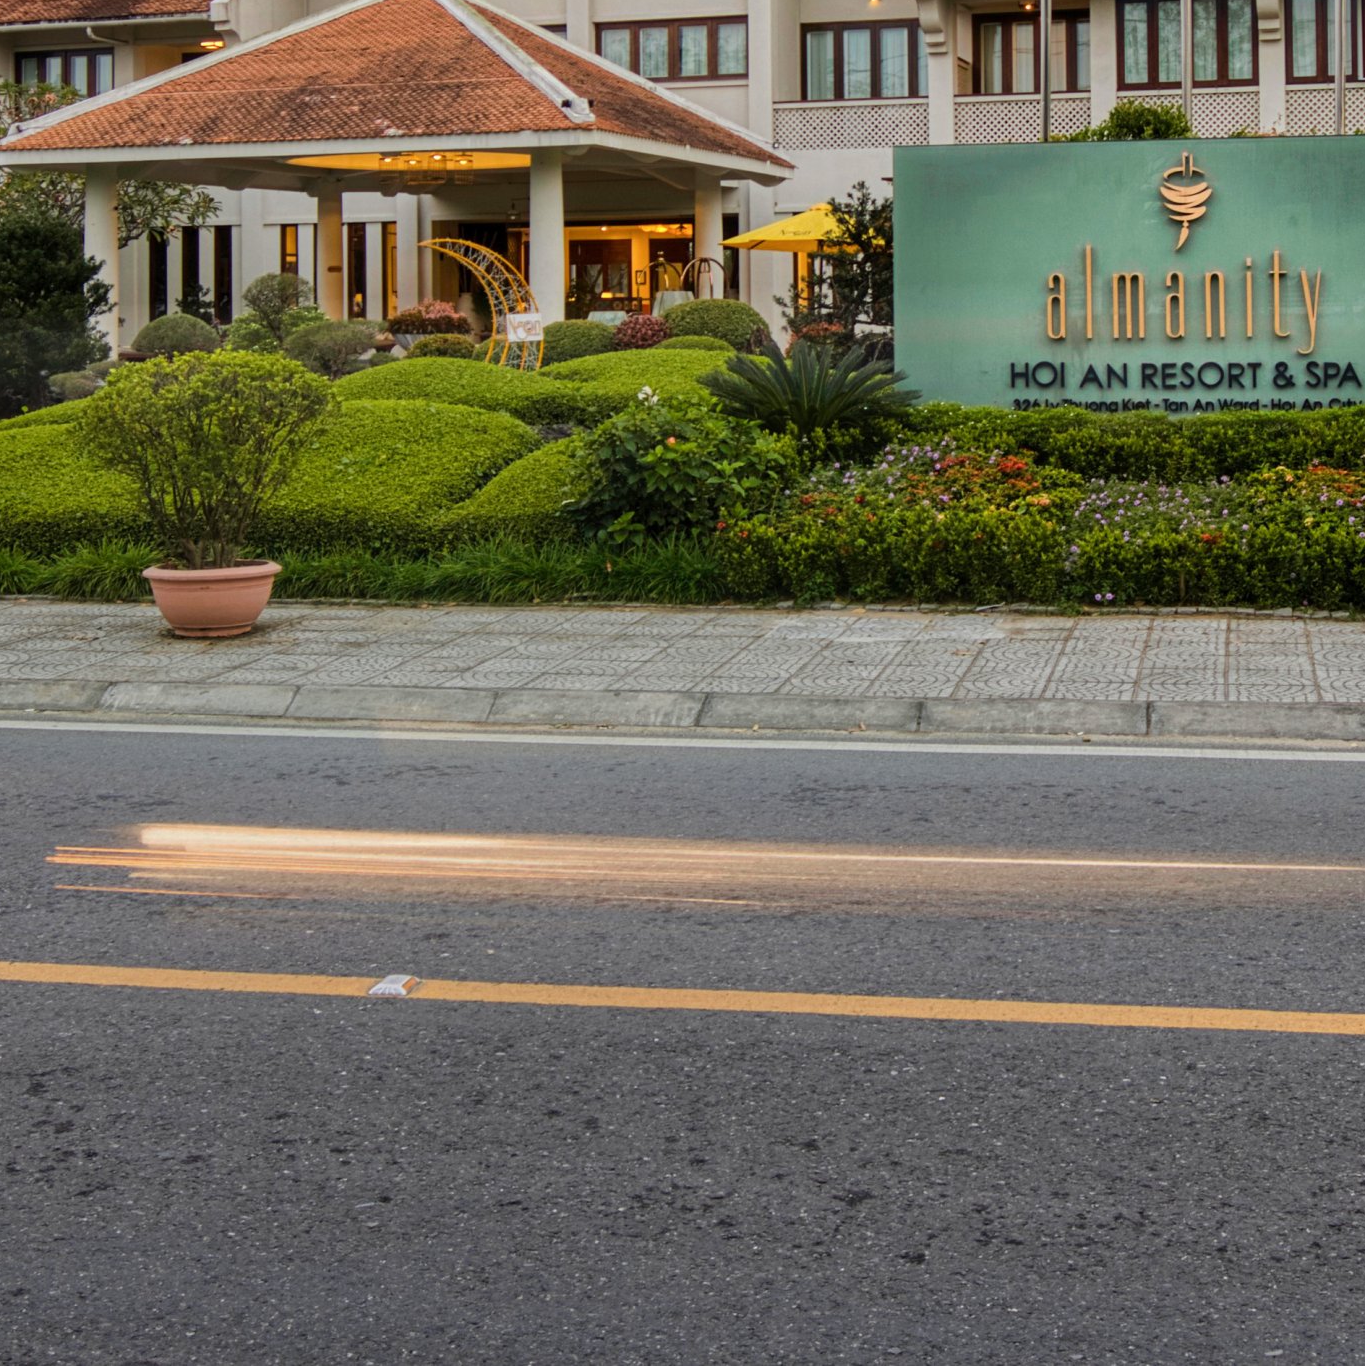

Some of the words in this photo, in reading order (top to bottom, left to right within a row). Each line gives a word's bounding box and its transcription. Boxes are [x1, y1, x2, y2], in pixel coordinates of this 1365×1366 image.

[1046, 243, 1322, 355] almanity
[1010, 361, 1066, 389] HOI
[1079, 362, 1129, 389] AN
[1141, 361, 1262, 390] RESORT
[1272, 361, 1297, 389] &
[1305, 361, 1363, 389] SPA
[1162, 398, 1188, 412] Tan
[1192, 398, 1215, 412] An
[1217, 398, 1260, 411] Ward
[1270, 398, 1296, 411] Hoi
[1301, 398, 1324, 411] An
